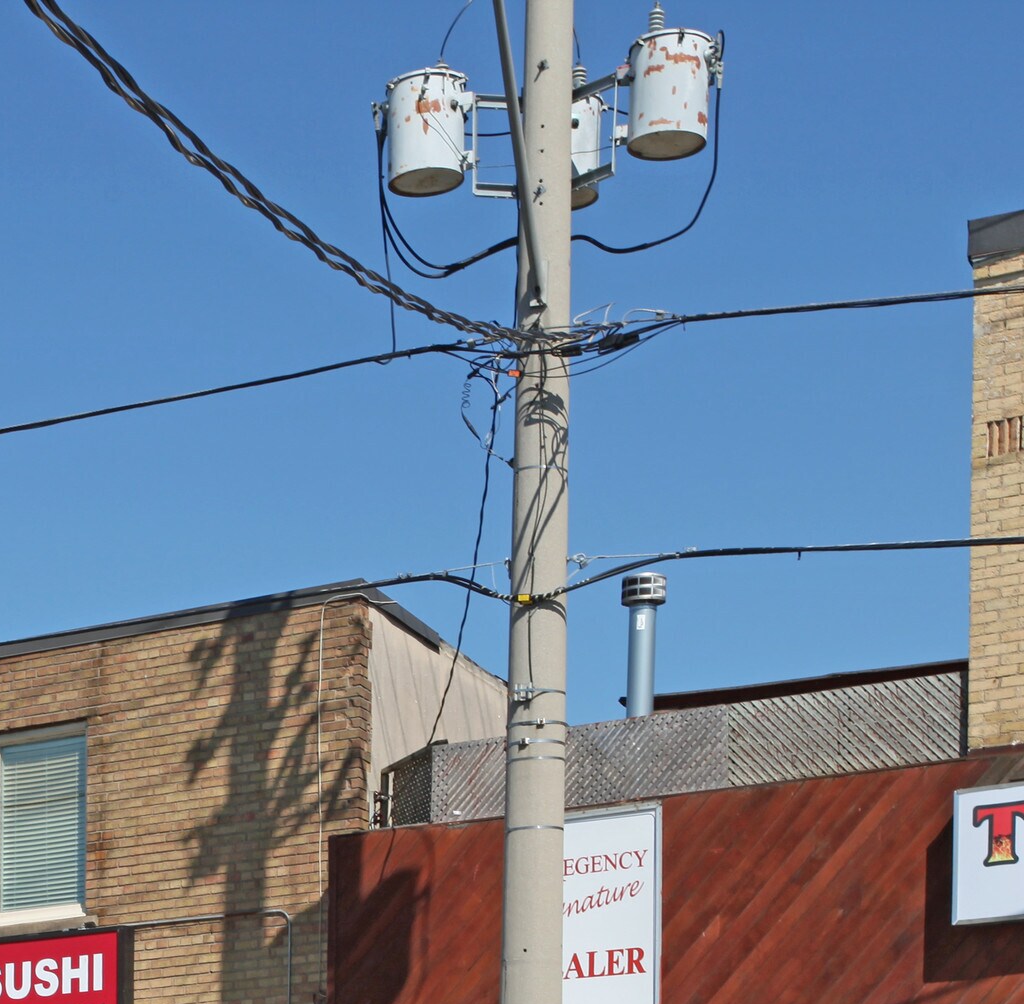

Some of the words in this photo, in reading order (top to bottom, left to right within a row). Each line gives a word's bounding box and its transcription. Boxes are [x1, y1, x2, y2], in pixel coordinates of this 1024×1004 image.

[973, 800, 1024, 867] T
[563, 849, 648, 878] EGENCY
[562, 879, 645, 917] nature
[562, 947, 646, 980] ALER
